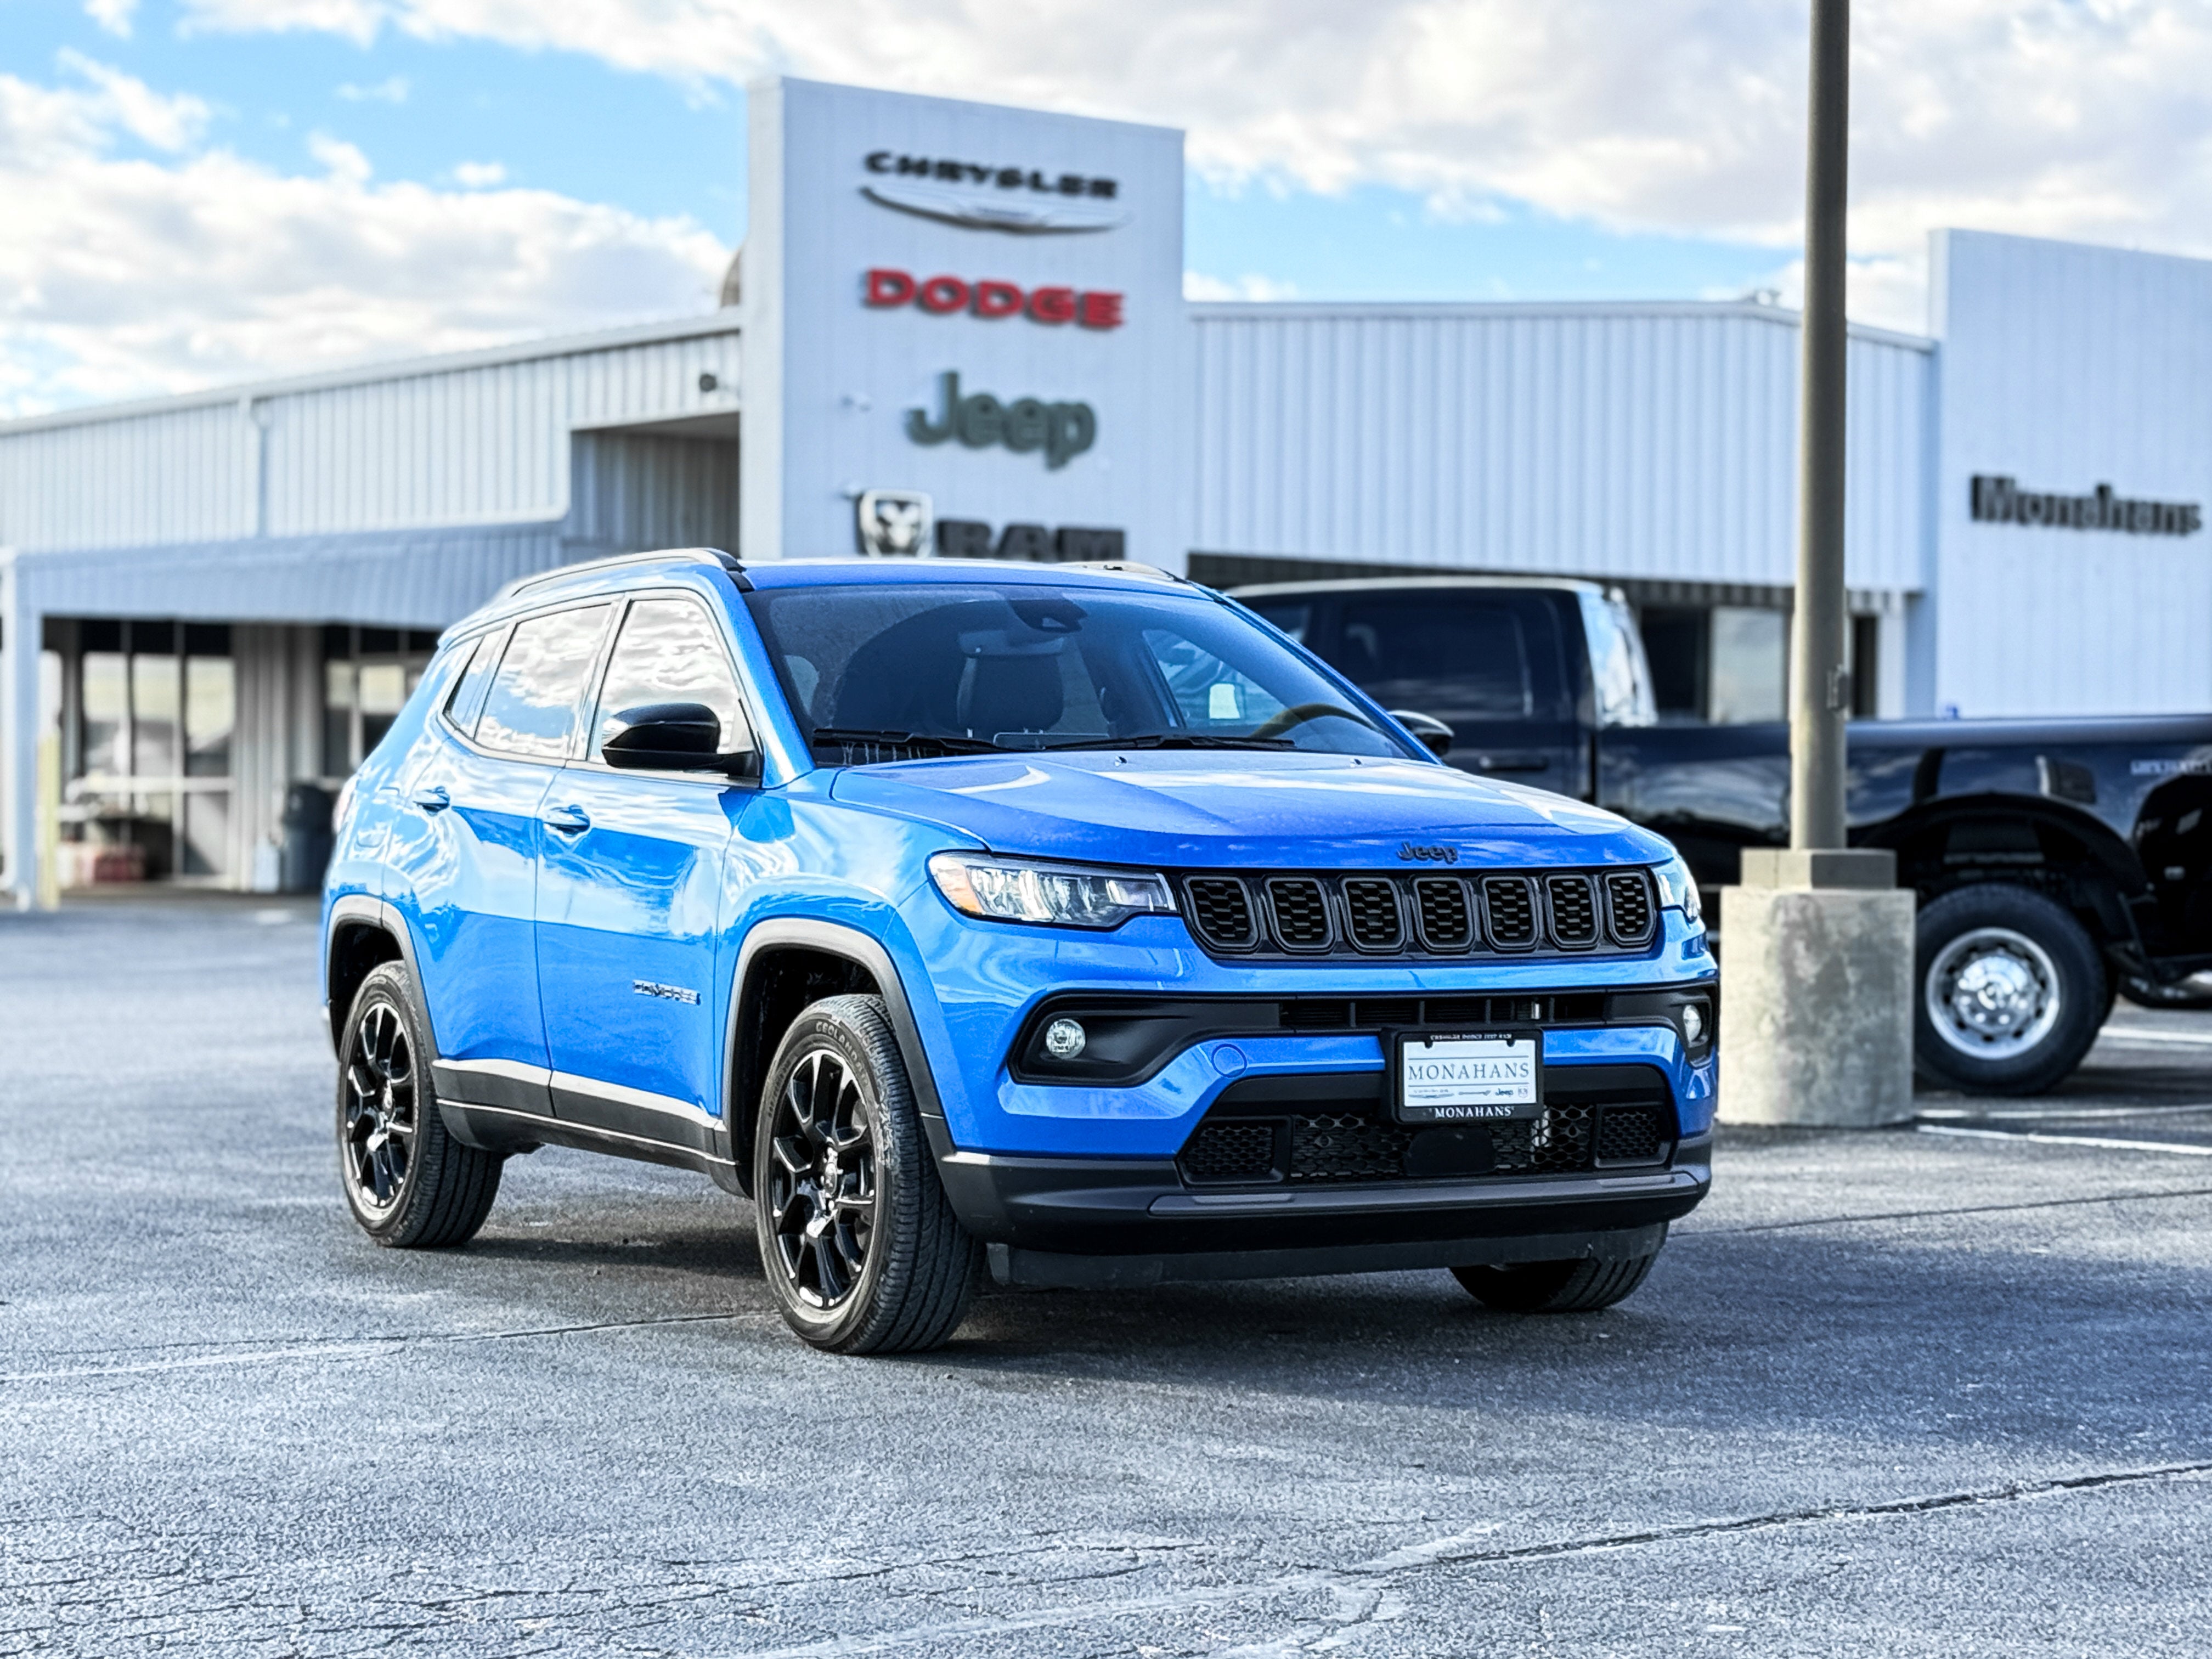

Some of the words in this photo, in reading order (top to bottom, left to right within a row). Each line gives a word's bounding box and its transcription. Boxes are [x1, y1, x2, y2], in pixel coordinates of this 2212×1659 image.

[865, 151, 1118, 198] CHRYSLER
[866, 269, 1125, 330] DODGE
[906, 370, 1096, 471] Jeep
[938, 520, 1125, 562] RAM
[1397, 842, 1458, 865] Jeep
[1408, 1062, 1530, 1081] MONAHANS
[1435, 1106, 1512, 1119] MONAHANS
